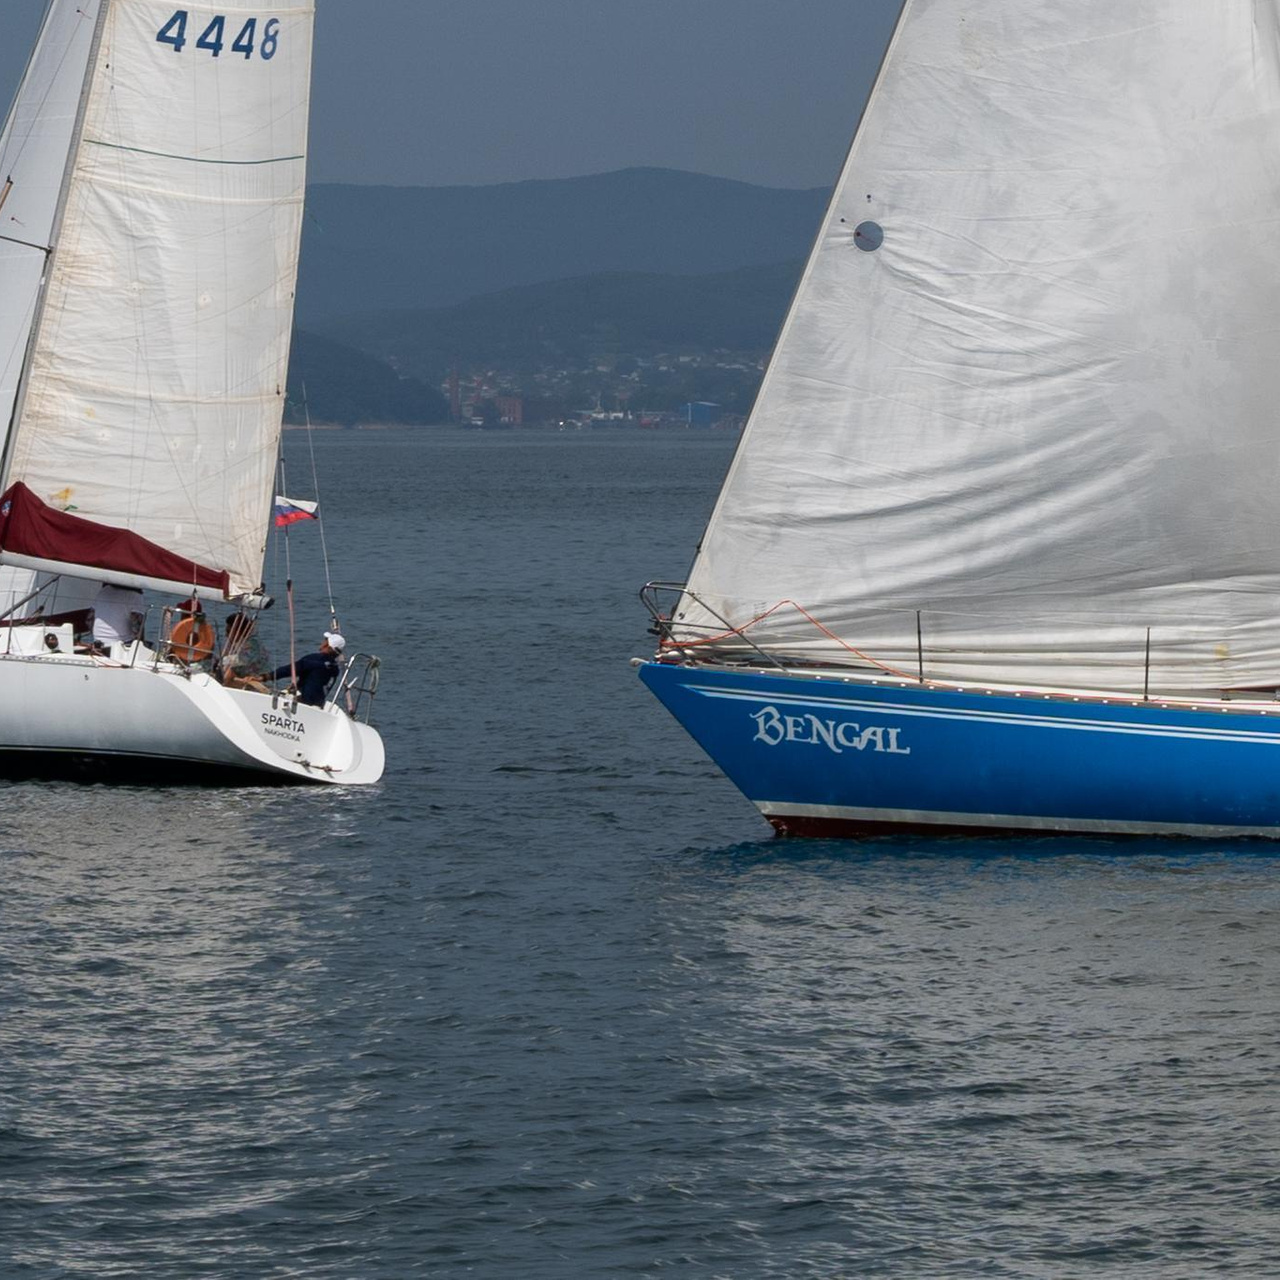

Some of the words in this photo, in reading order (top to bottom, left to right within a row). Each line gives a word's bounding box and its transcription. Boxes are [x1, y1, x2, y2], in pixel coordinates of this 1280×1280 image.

[155, 9, 280, 60] 4448
[260, 712, 306, 735] SPARTA
[749, 706, 910, 755] BENGAL
